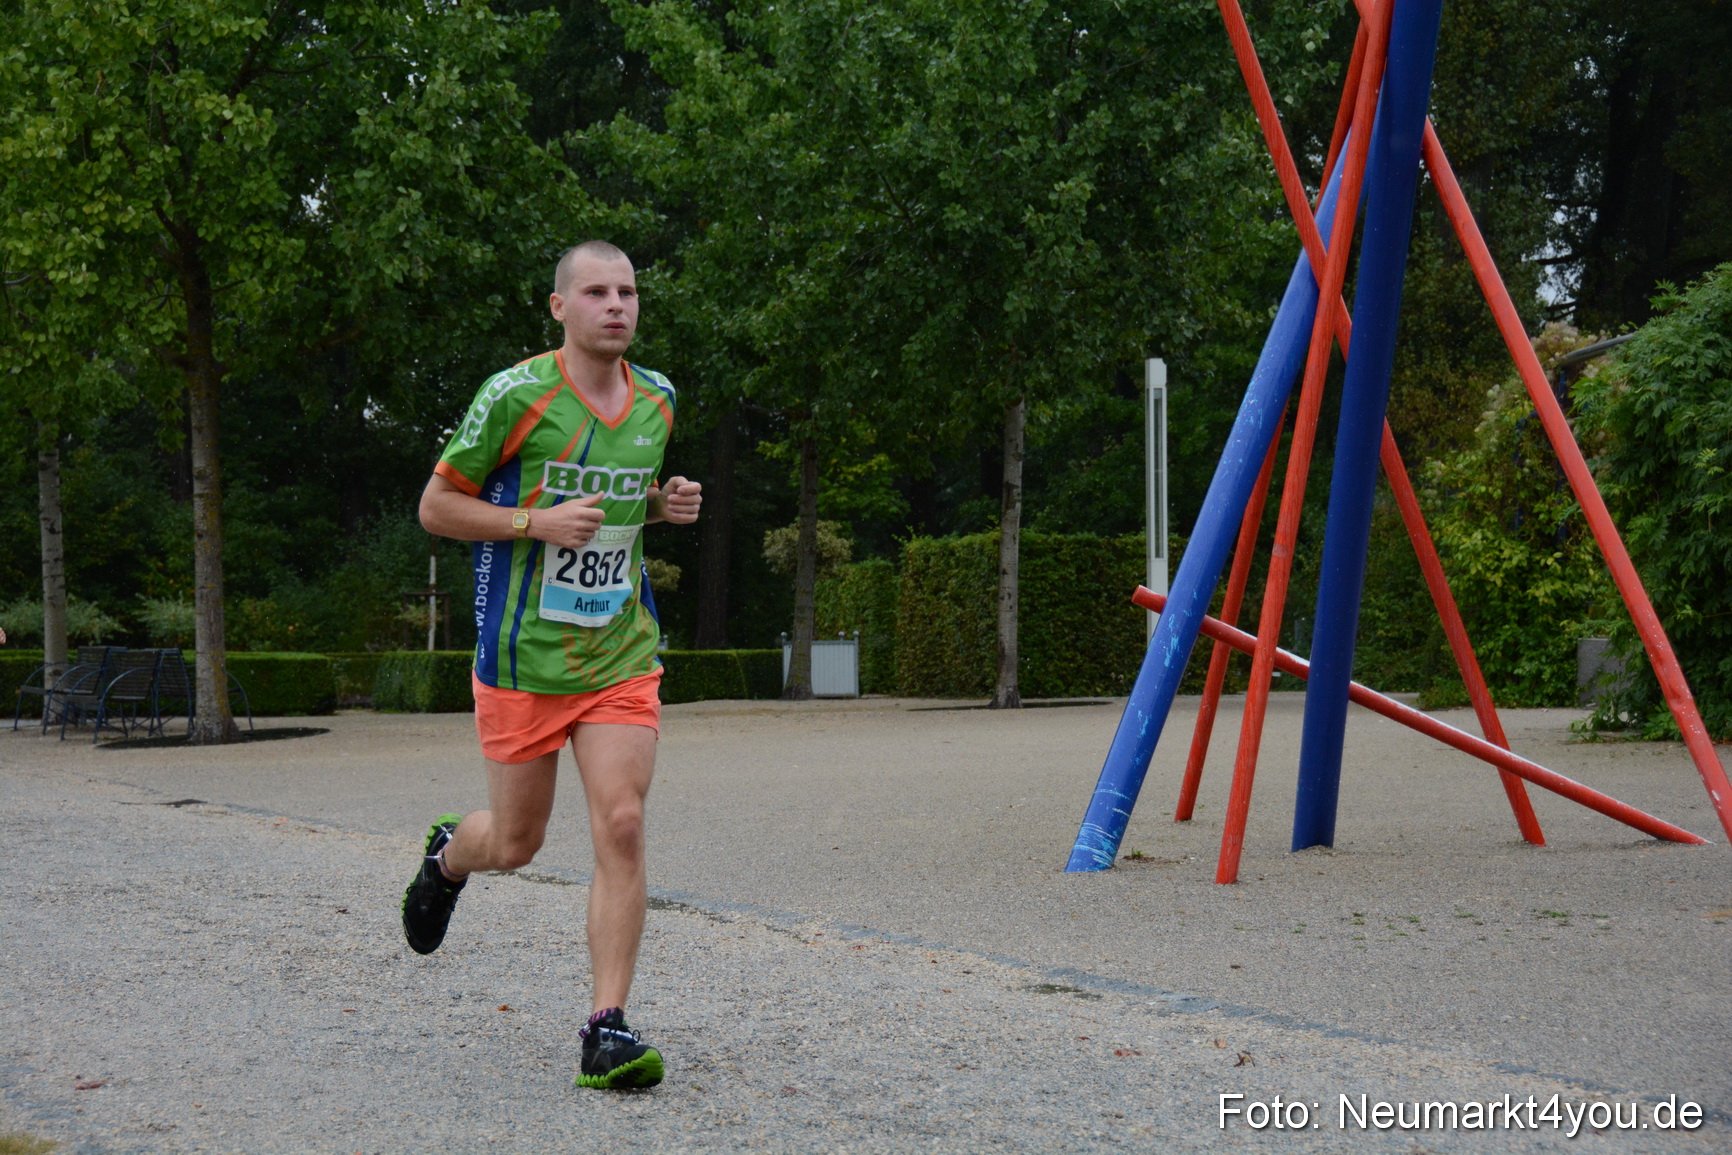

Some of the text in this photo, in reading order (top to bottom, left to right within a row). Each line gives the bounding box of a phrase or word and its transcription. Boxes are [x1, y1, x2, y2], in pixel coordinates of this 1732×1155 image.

[460, 366, 541, 448] BOCK
[556, 547, 627, 588] 2852
[574, 596, 611, 613] Arthur
